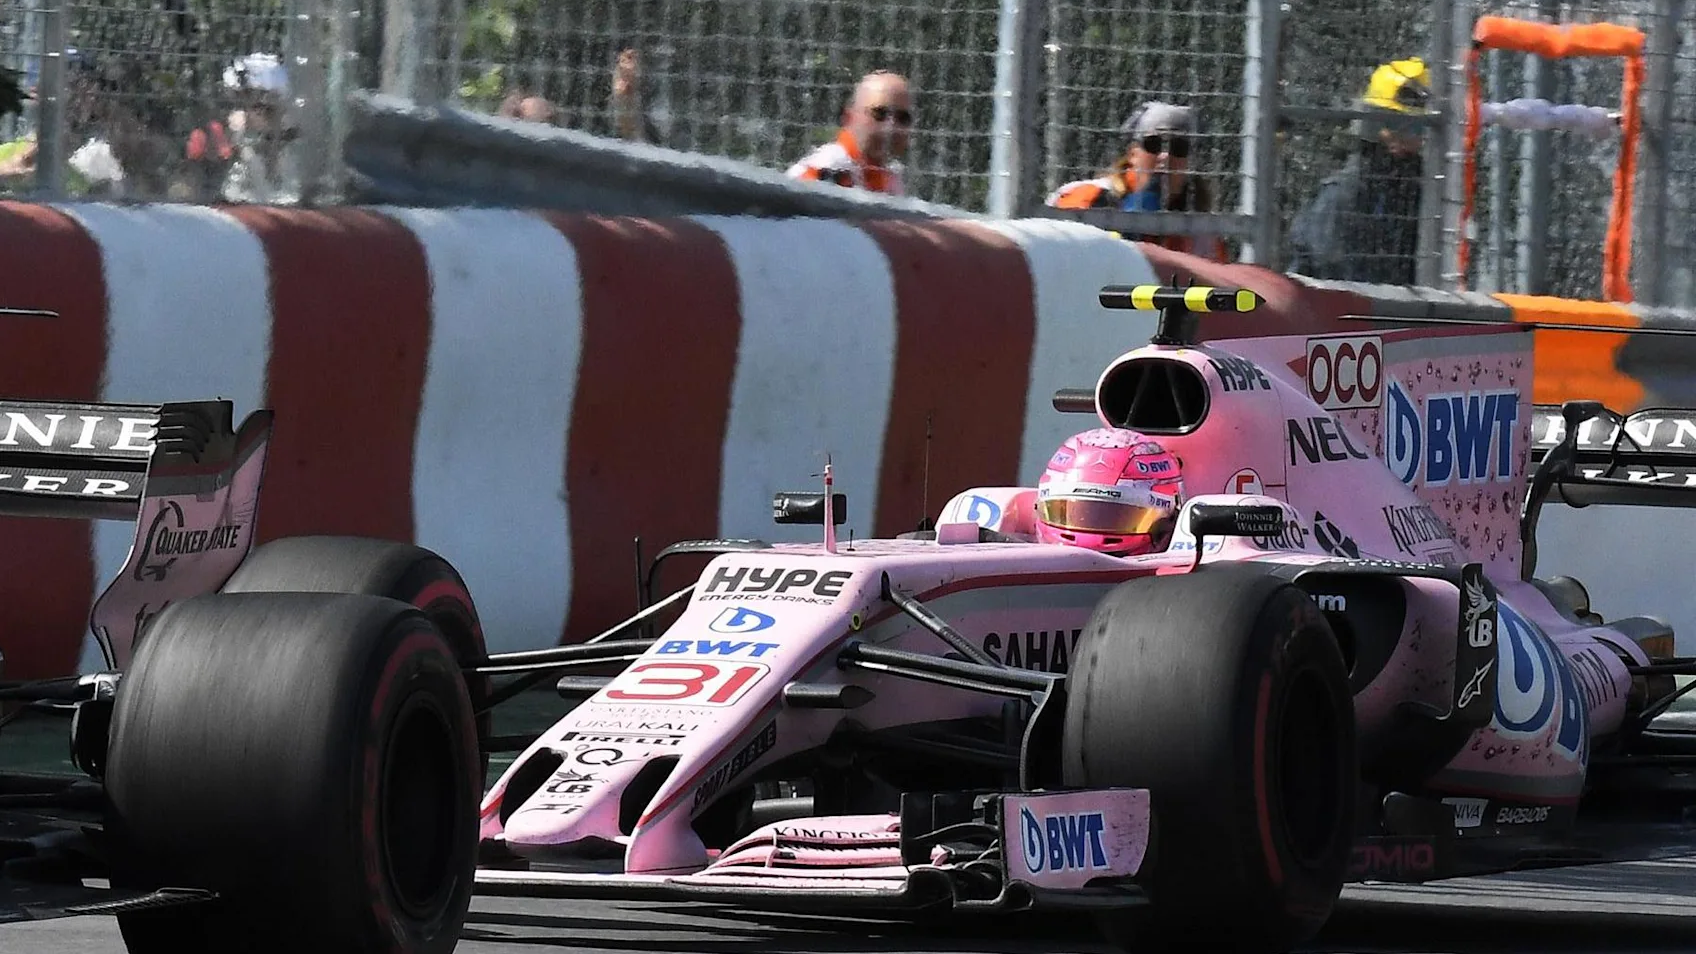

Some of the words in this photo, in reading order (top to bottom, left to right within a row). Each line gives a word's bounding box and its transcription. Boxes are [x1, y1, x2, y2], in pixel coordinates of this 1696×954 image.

[1208, 358, 1271, 392] HYPE
[1309, 342, 1381, 404] OCO
[1287, 417, 1368, 466] NEC
[1426, 393, 1521, 482] BWT
[704, 567, 853, 597] HYPE
[772, 596, 834, 606] DRINKS
[655, 640, 780, 657] BWT
[606, 662, 761, 703] 31
[560, 732, 687, 746] PIRELLI
[575, 720, 699, 731] URALKALI
[1046, 813, 1107, 871] BWT
